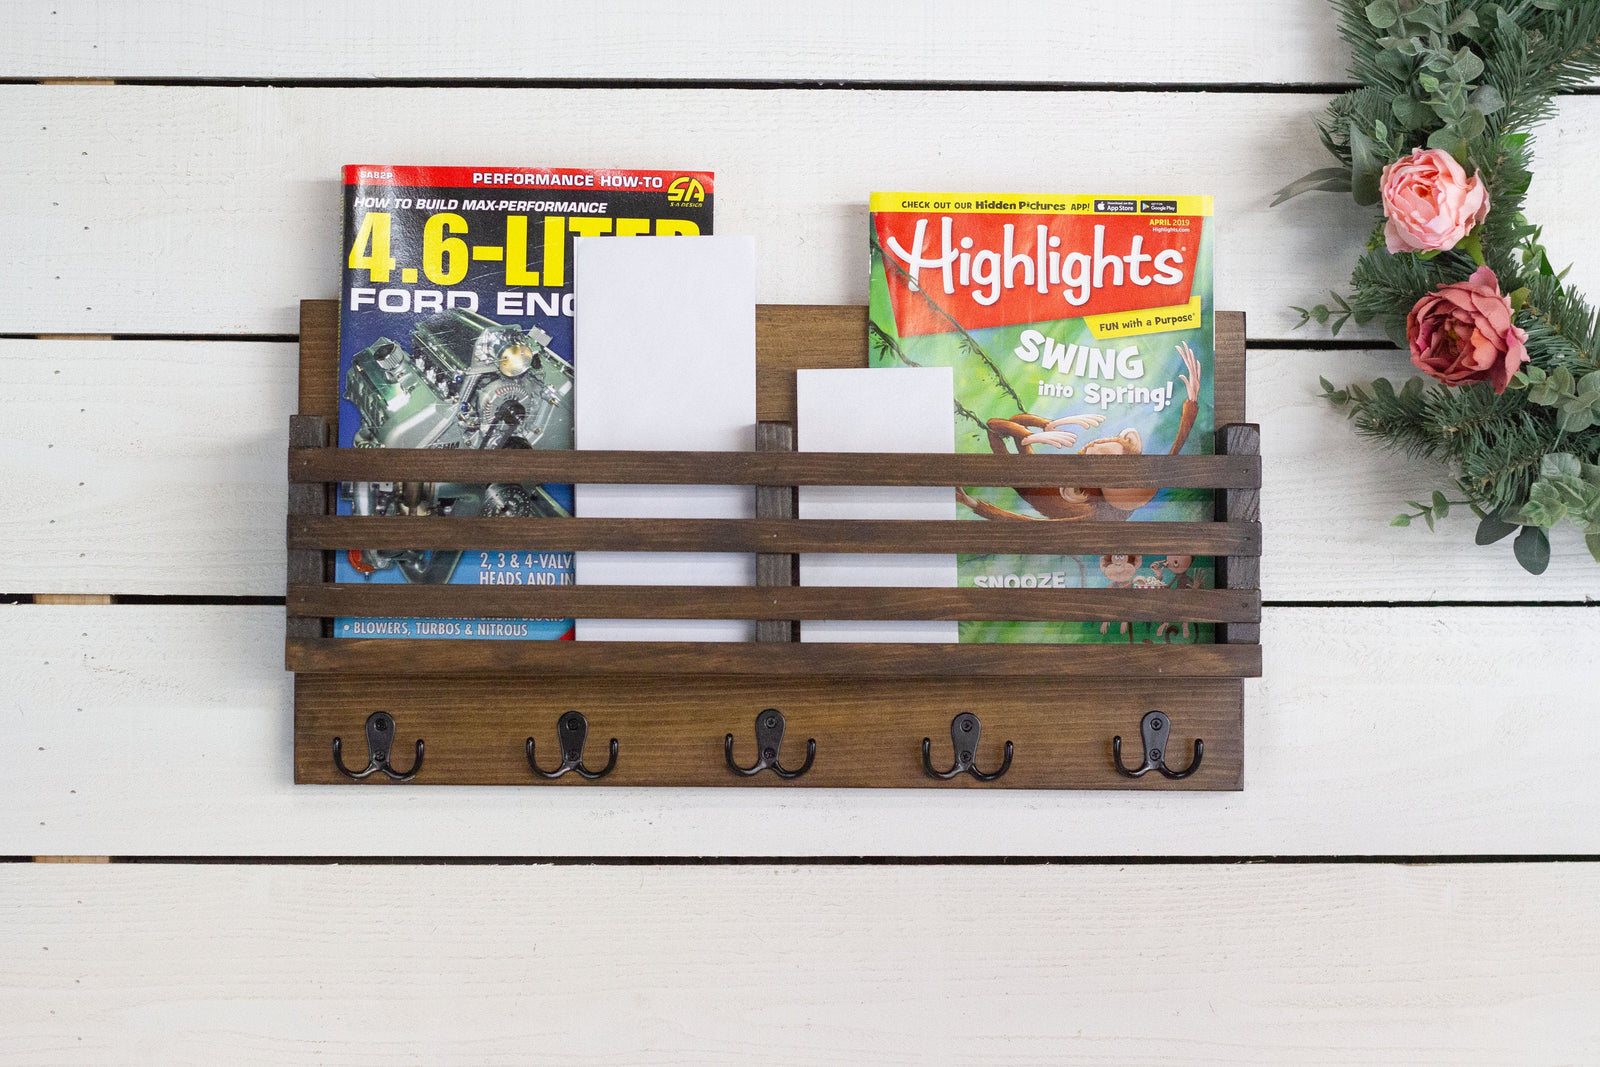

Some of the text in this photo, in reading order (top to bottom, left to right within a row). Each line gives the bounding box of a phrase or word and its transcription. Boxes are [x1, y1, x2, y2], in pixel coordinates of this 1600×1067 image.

[360, 171, 663, 189] SA82P PERFORMANCE HOW-TO
[667, 176, 705, 202] SA
[354, 196, 608, 214] HOW TO BUILD MAX-PERFORMANCE
[901, 200, 1090, 211] CHECK OUT OUR Hidden Pictures APP!
[886, 216, 1185, 306] Highlights
[349, 287, 479, 314] FORD
[1099, 315, 1193, 332] FUN with a Purpose
[1013, 329, 1145, 380] SWING
[1038, 381, 1174, 412] into Spring!
[479, 552, 492, 570] 2,
[497, 552, 506, 568] 3
[510, 553, 520, 568] &
[479, 571, 522, 585] HEADS
[527, 571, 556, 585] AND
[354, 621, 528, 637] BLOWERS, TURBOS & NITROUS
